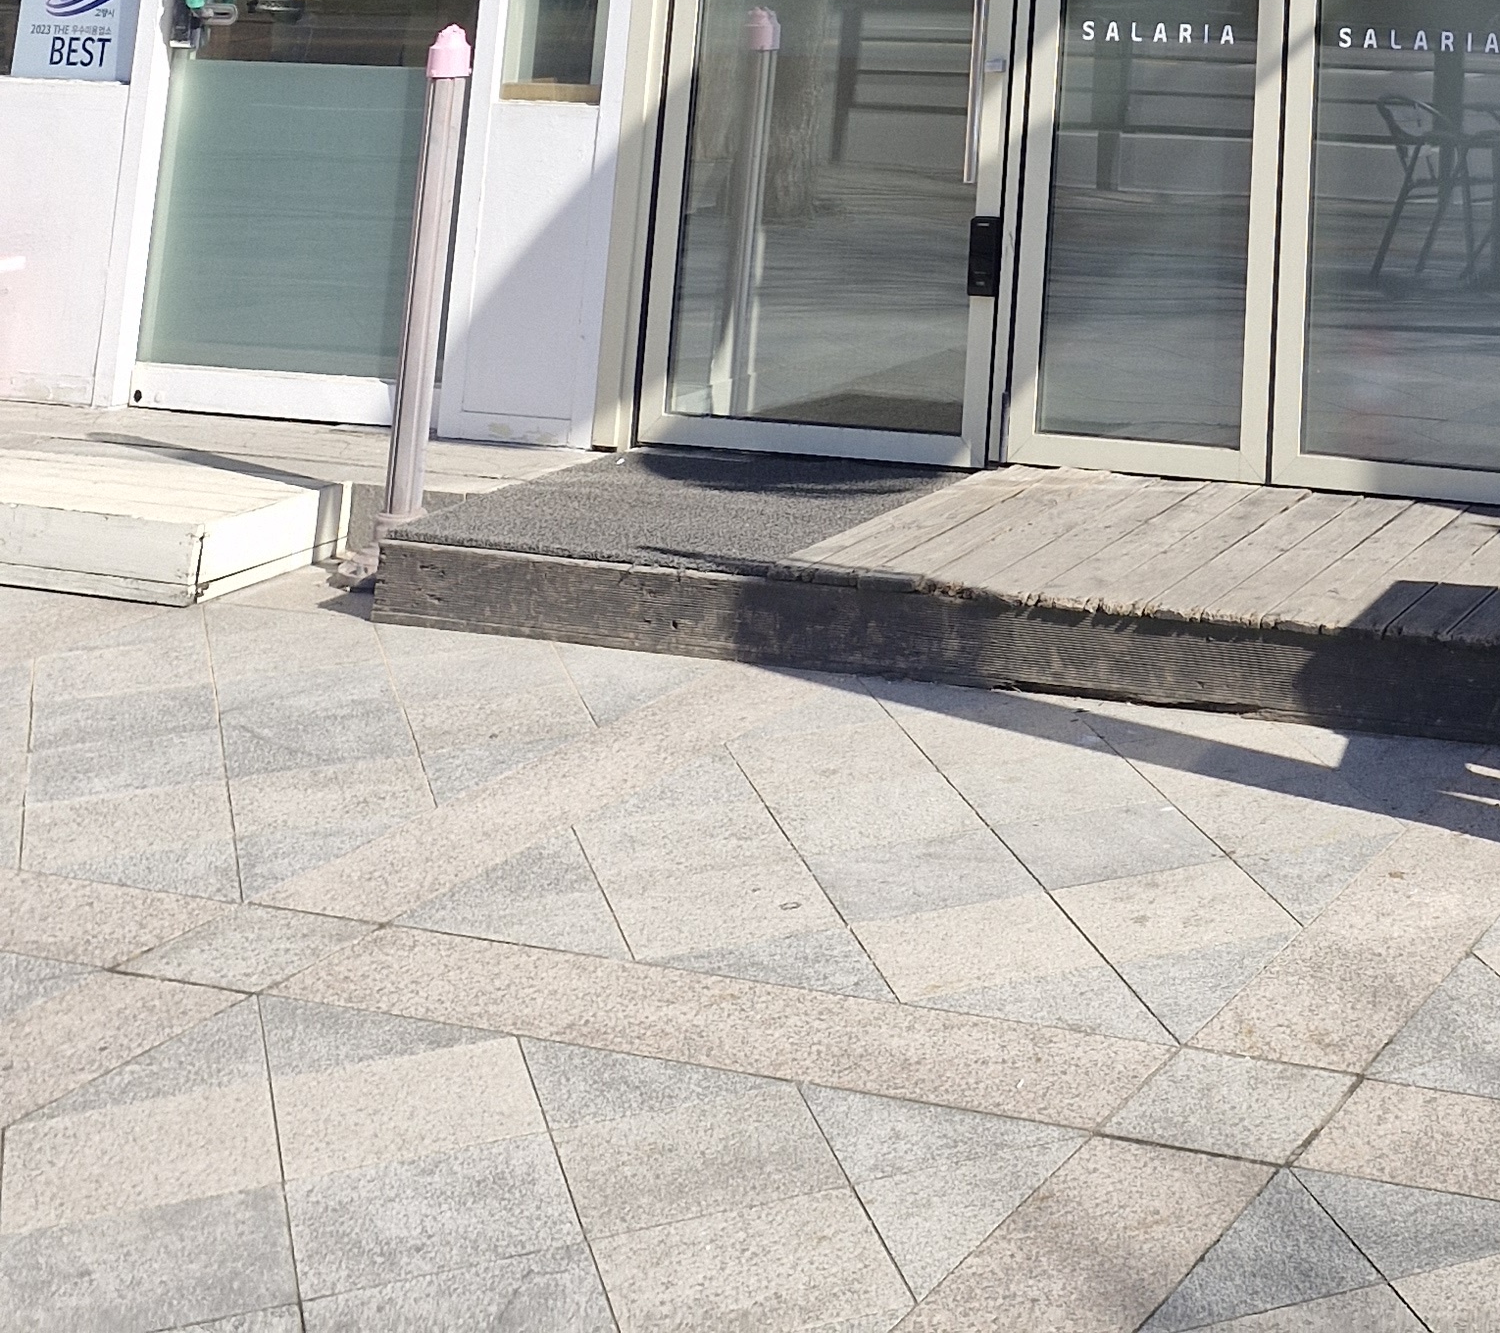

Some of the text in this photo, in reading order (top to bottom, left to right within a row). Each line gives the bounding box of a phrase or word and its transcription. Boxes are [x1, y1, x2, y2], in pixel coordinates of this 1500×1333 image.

[30, 24, 51, 35] 2023
[53, 24, 70, 35] THE
[1081, 20, 1235, 45] SALARIA
[1337, 27, 1500, 53] SALARIA
[49, 36, 112, 68] BEST
